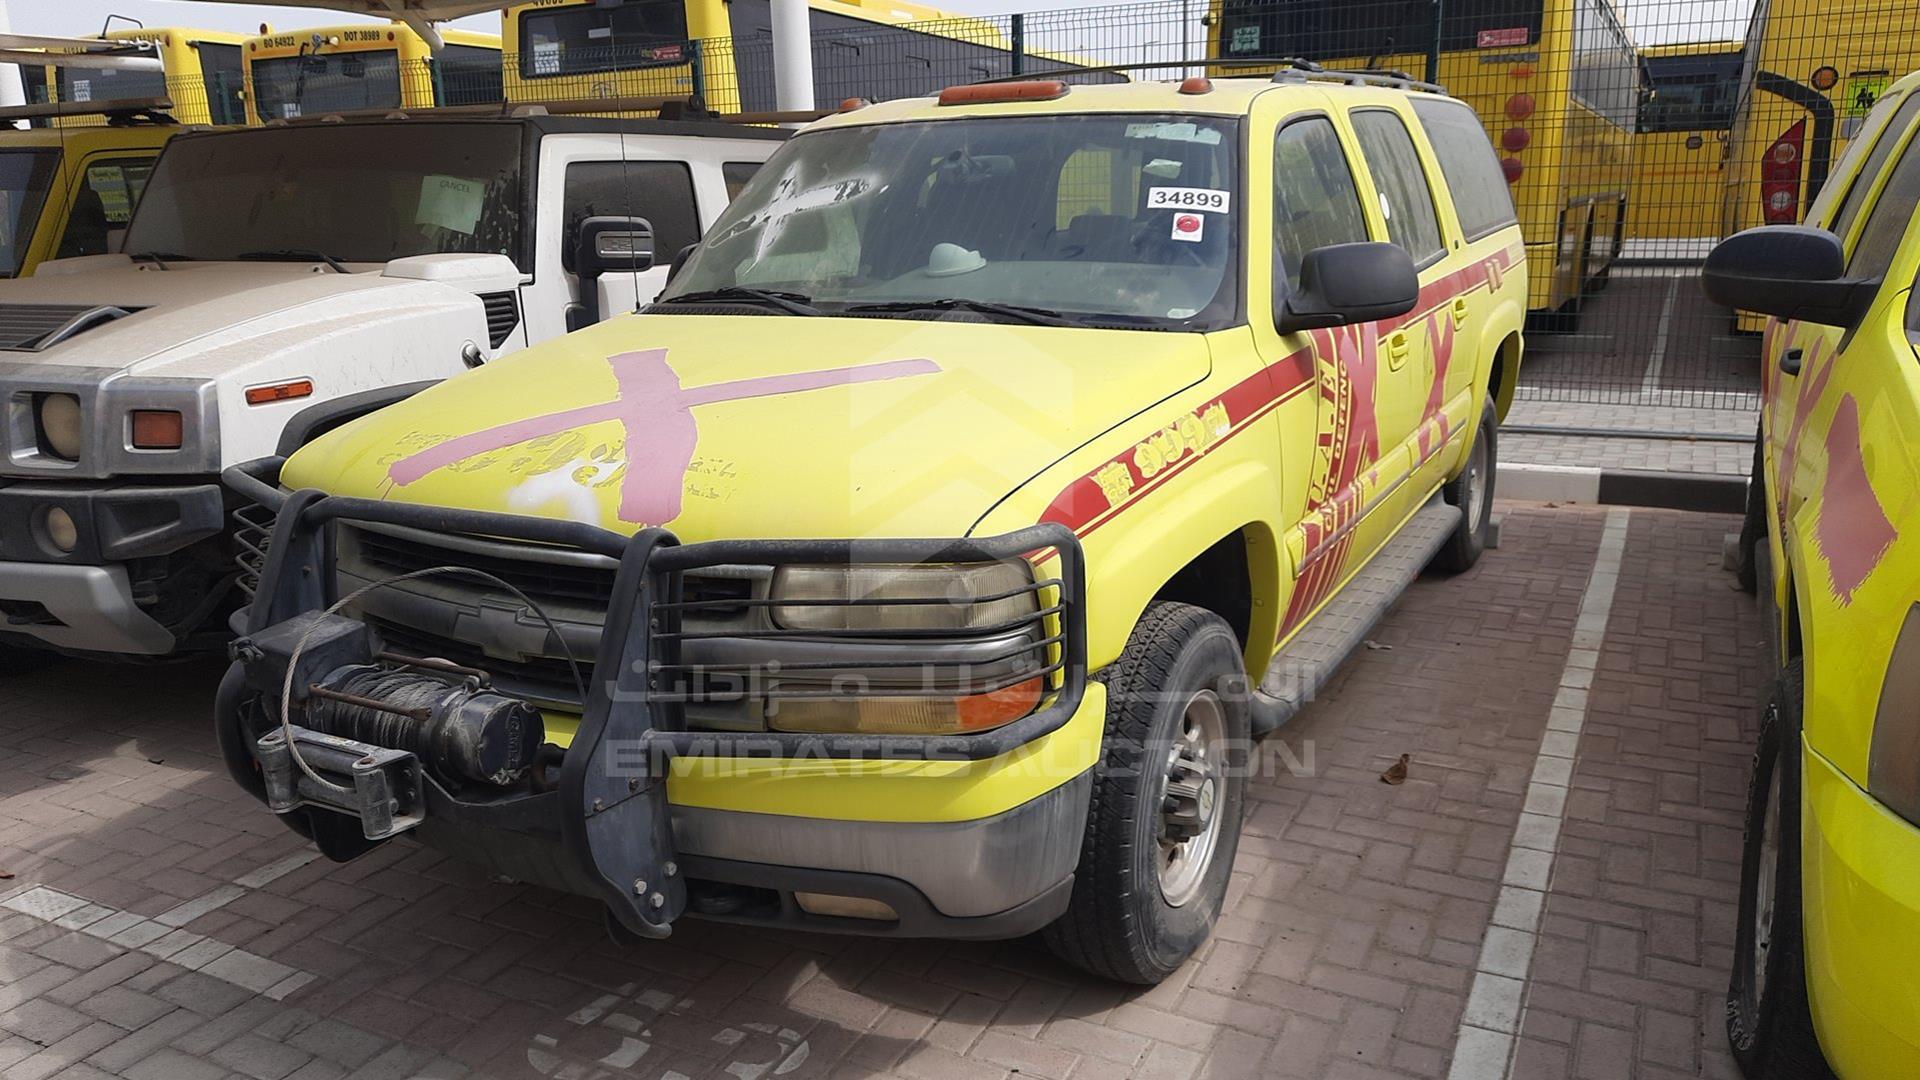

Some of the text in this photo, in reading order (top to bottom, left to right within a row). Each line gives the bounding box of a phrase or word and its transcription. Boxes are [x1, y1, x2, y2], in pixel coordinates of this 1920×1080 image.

[344, 31, 357, 41] DOT
[1154, 190, 1223, 208] 34899
[1335, 359, 1348, 459] DEFENC
